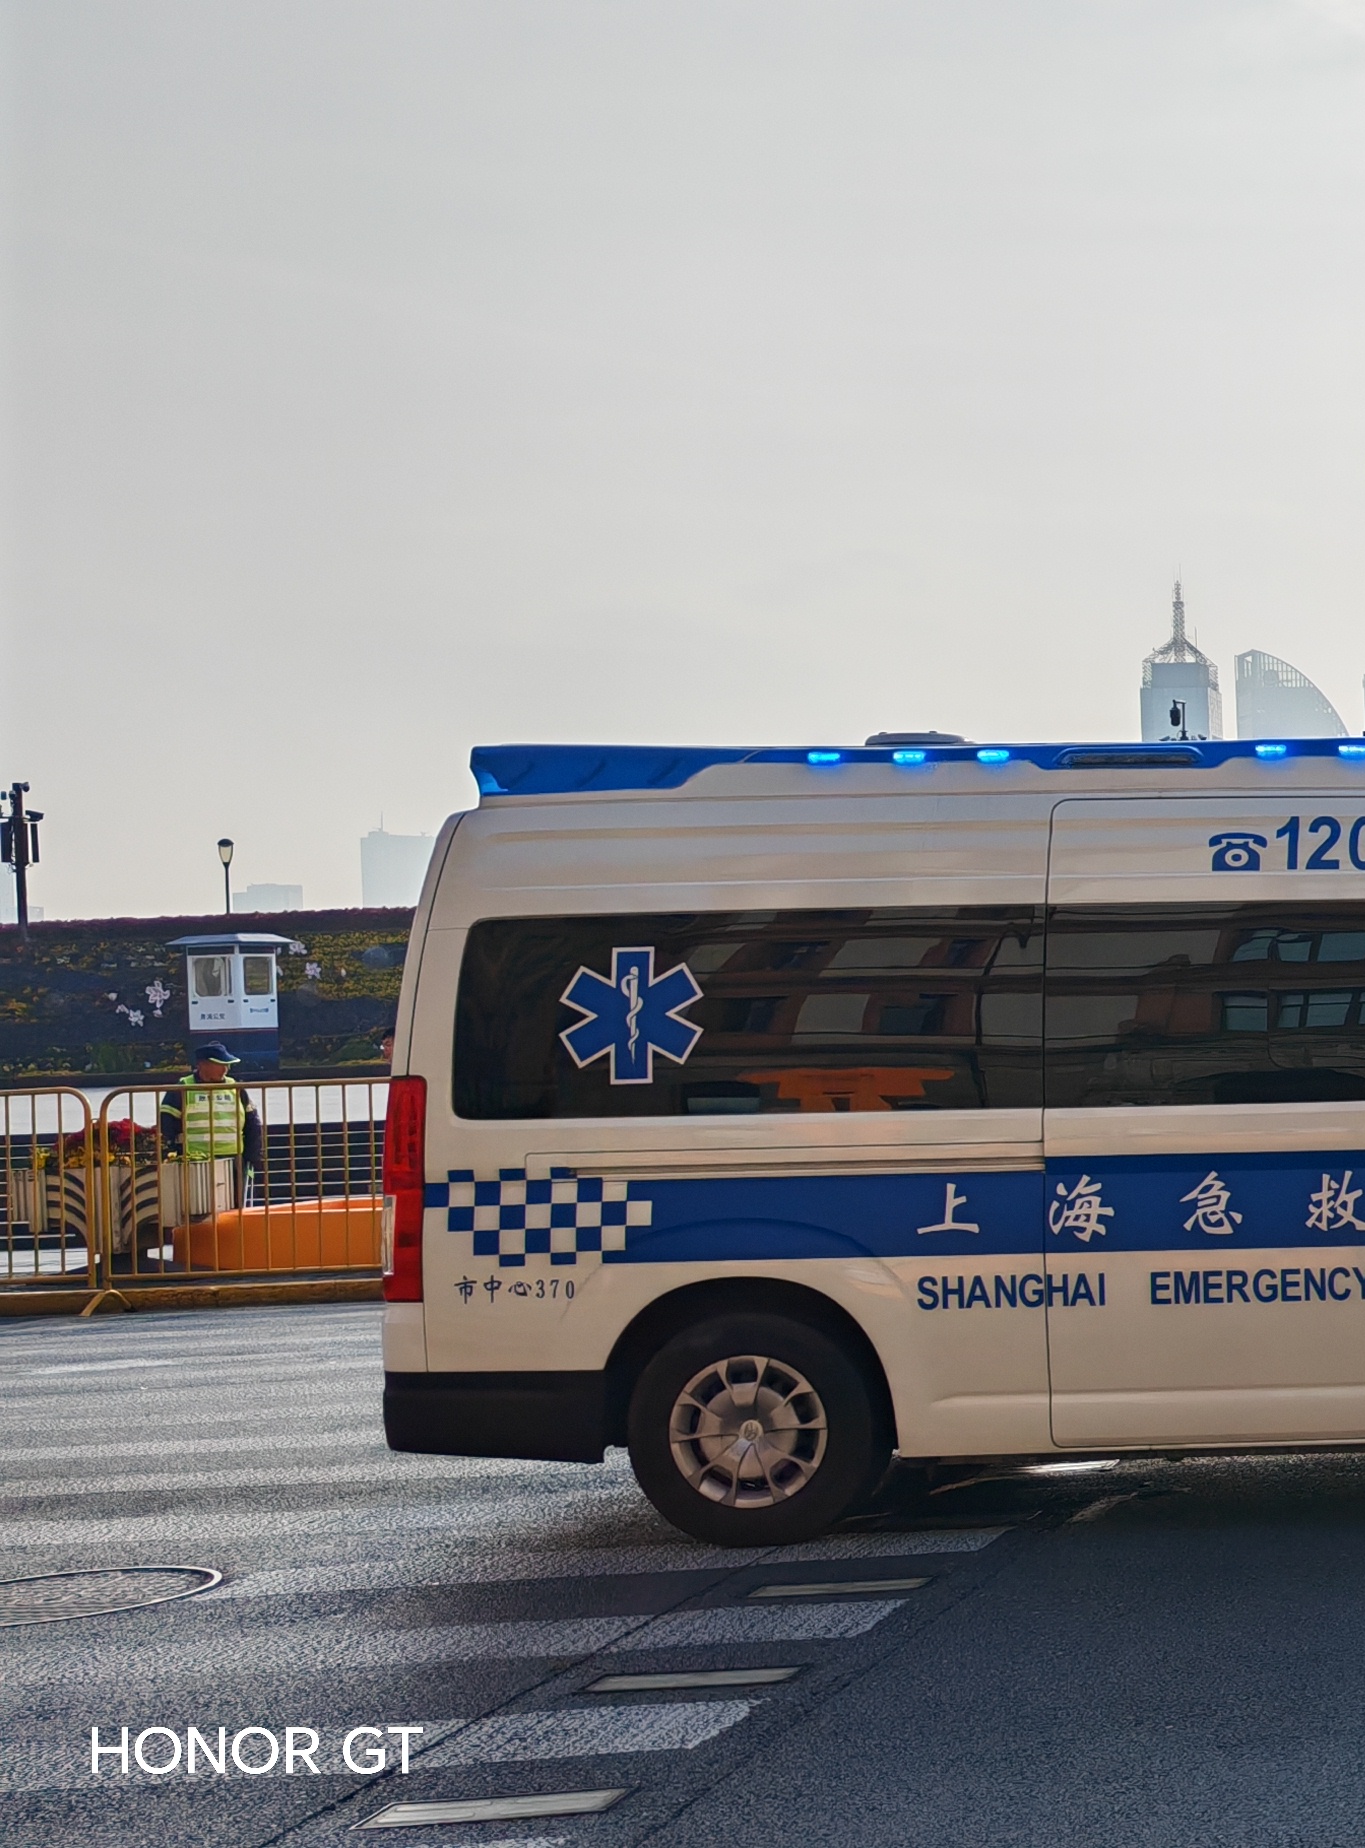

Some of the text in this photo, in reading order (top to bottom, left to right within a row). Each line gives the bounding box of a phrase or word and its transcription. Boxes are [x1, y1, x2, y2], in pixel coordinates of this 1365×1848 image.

[454, 1275, 575, 1304] 市中心370
[917, 1273, 1106, 1310] SHANGHAI
